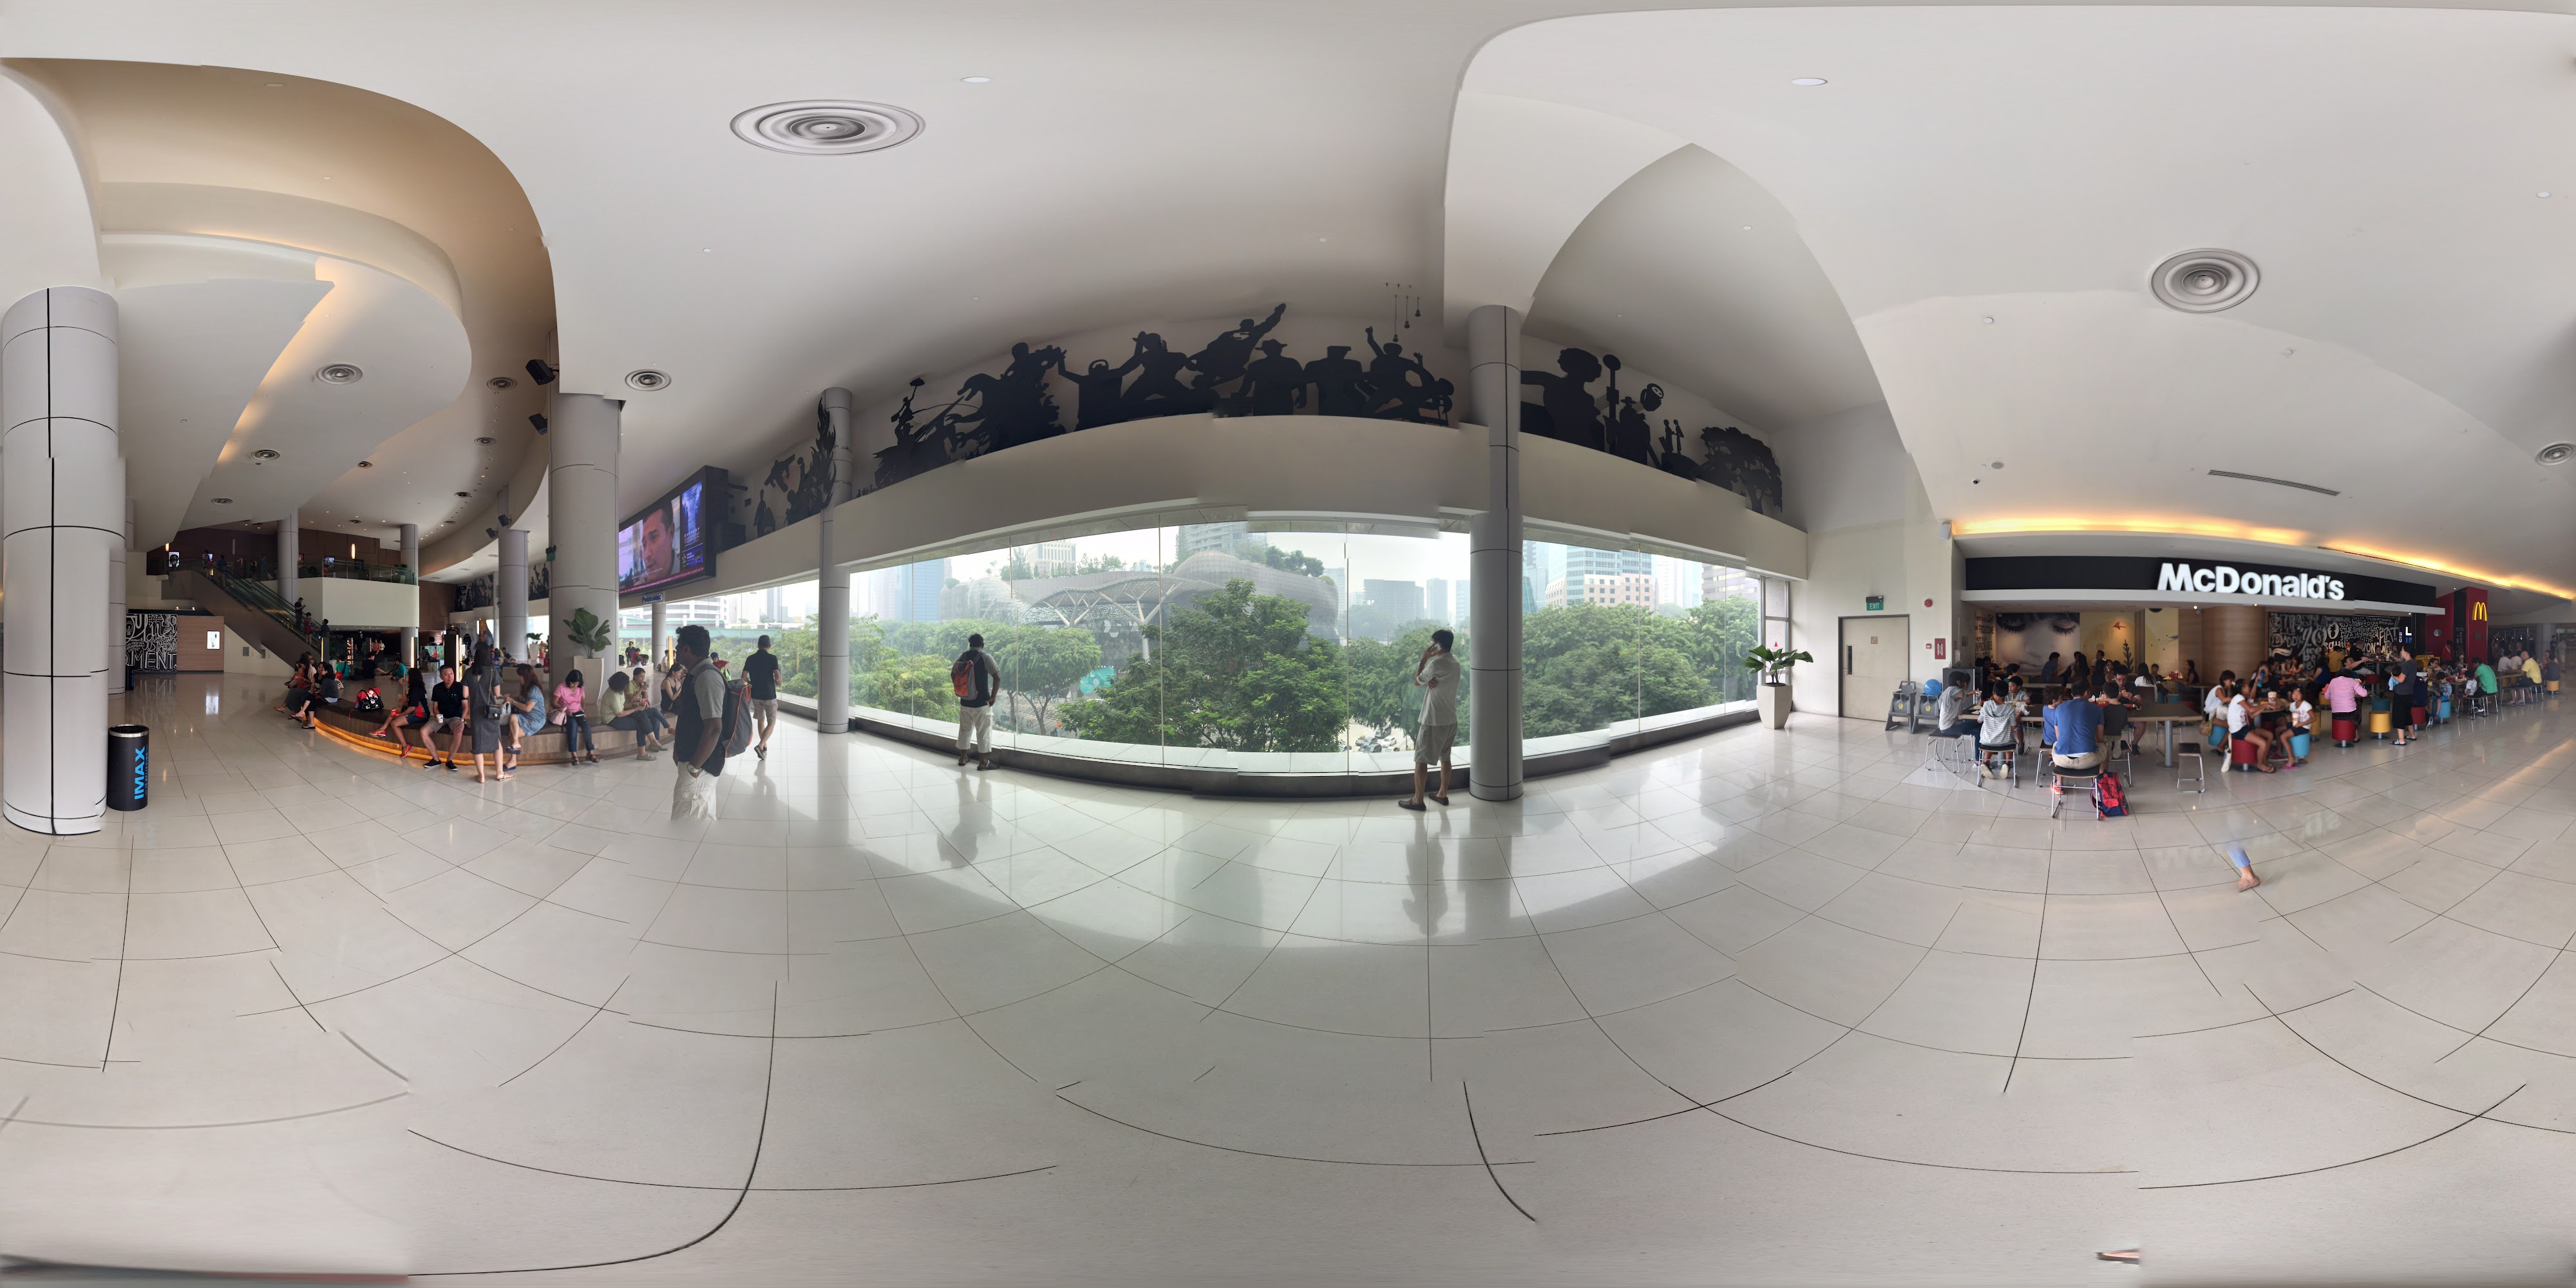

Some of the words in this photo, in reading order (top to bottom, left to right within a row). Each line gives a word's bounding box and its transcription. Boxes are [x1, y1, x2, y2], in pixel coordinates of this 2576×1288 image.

[2157, 562, 2345, 601] McDonald's
[2352, 619, 2364, 627] have
[135, 746, 145, 799] IMAX
